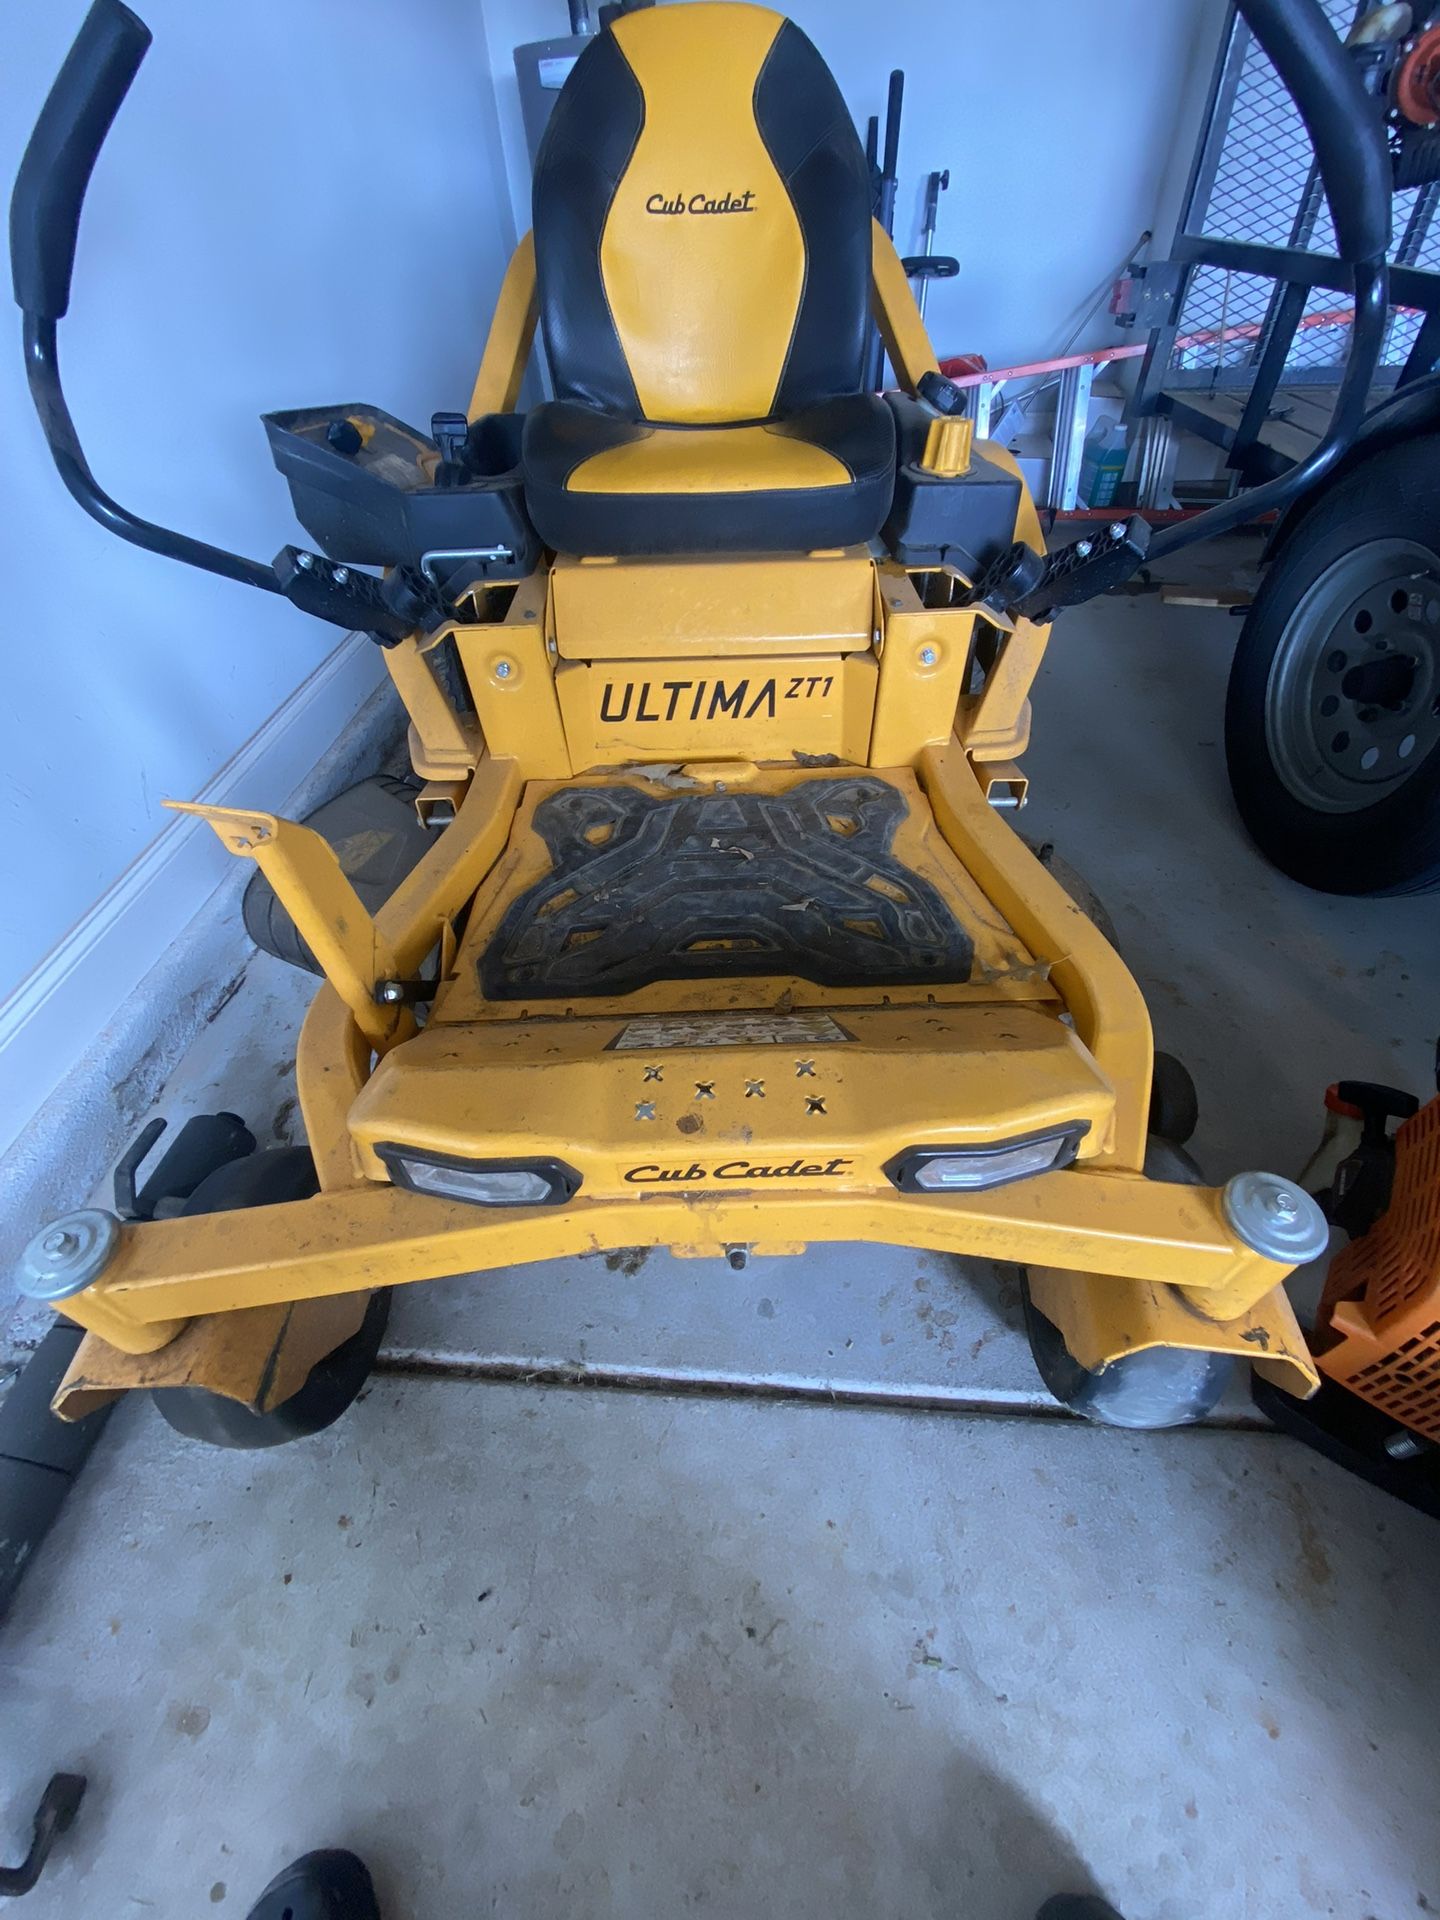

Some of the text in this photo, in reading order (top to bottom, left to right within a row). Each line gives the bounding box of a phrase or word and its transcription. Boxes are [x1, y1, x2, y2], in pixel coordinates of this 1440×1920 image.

[646, 190, 756, 215] Cub Cadet
[600, 676, 834, 722] ULTIMA ZT1
[624, 1158, 854, 1183] Cub Cadet
